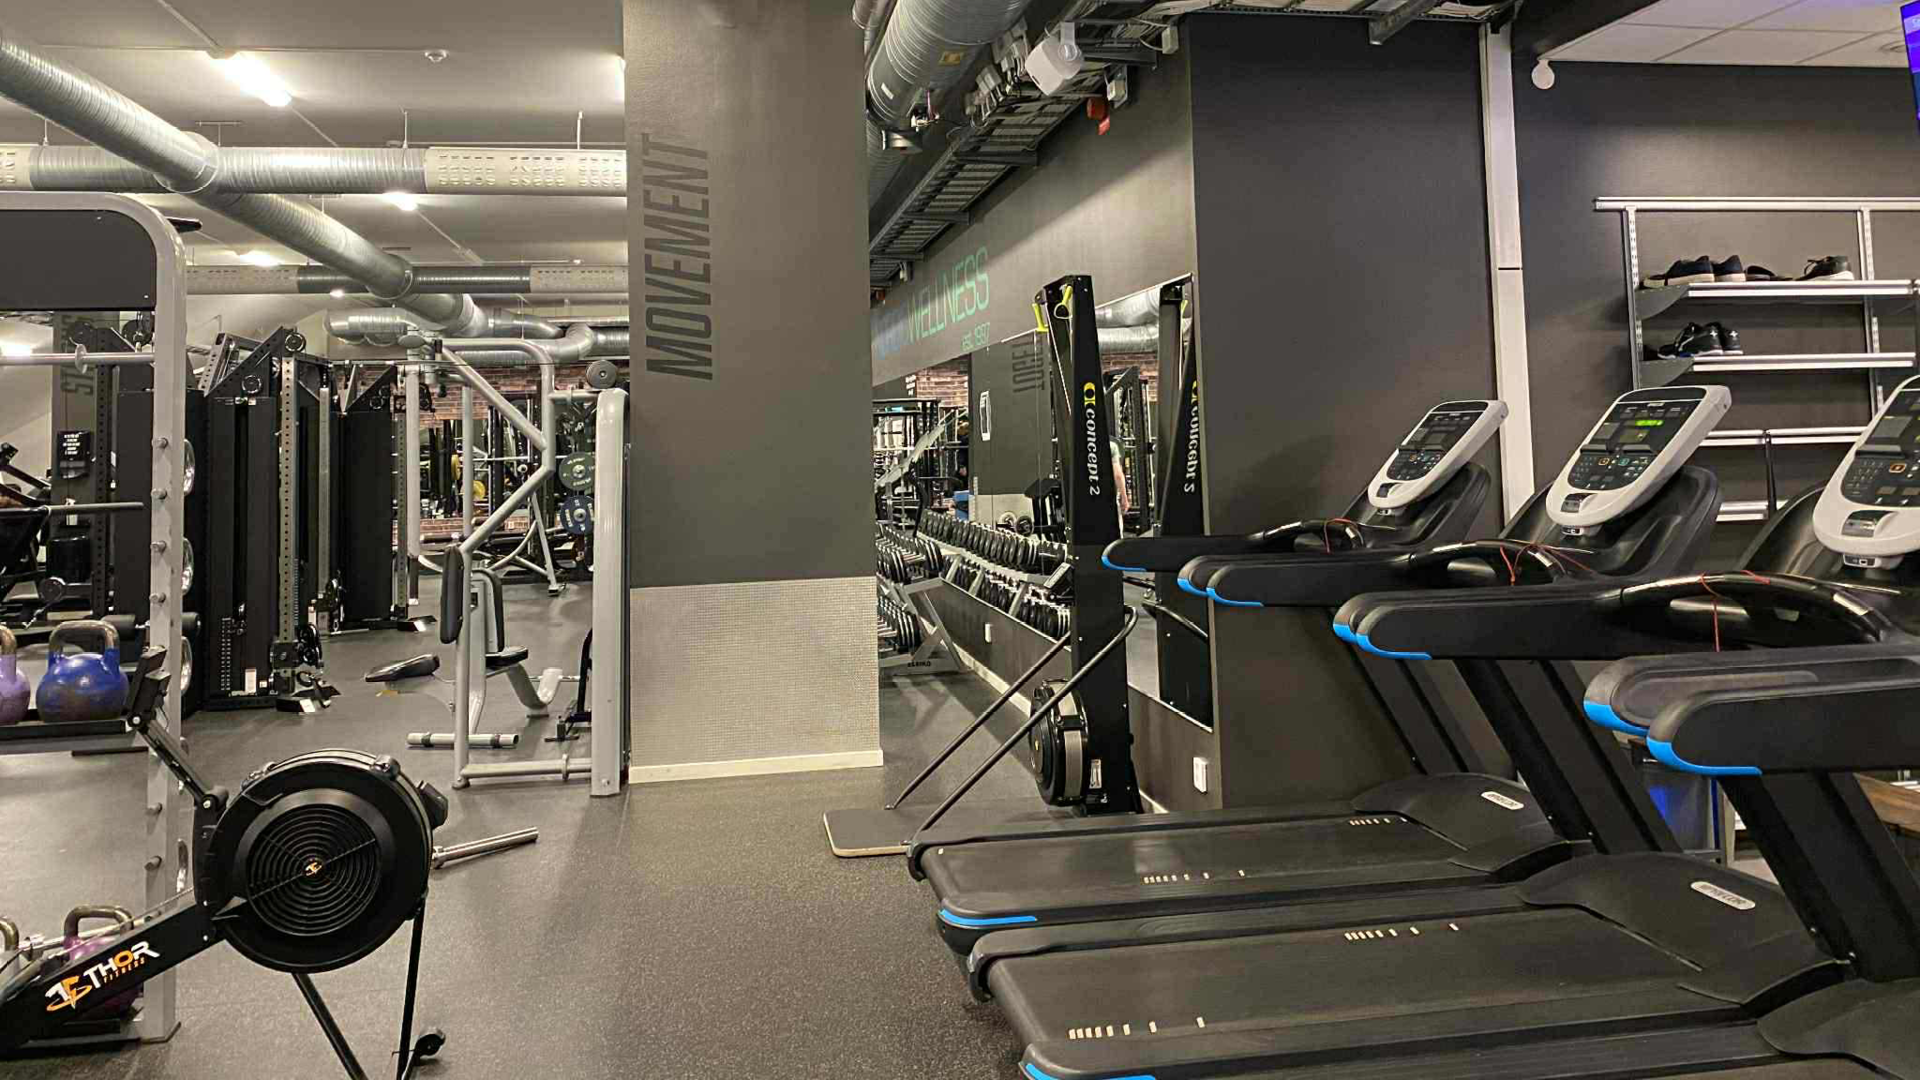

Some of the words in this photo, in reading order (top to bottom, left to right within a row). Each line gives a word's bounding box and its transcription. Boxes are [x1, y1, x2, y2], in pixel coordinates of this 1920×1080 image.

[642, 132, 713, 381] MOVEMENT
[907, 246, 990, 345] WELLNESS
[1085, 408, 1098, 482] concept
[1089, 485, 1101, 496] 2
[83, 940, 160, 989] THOR
